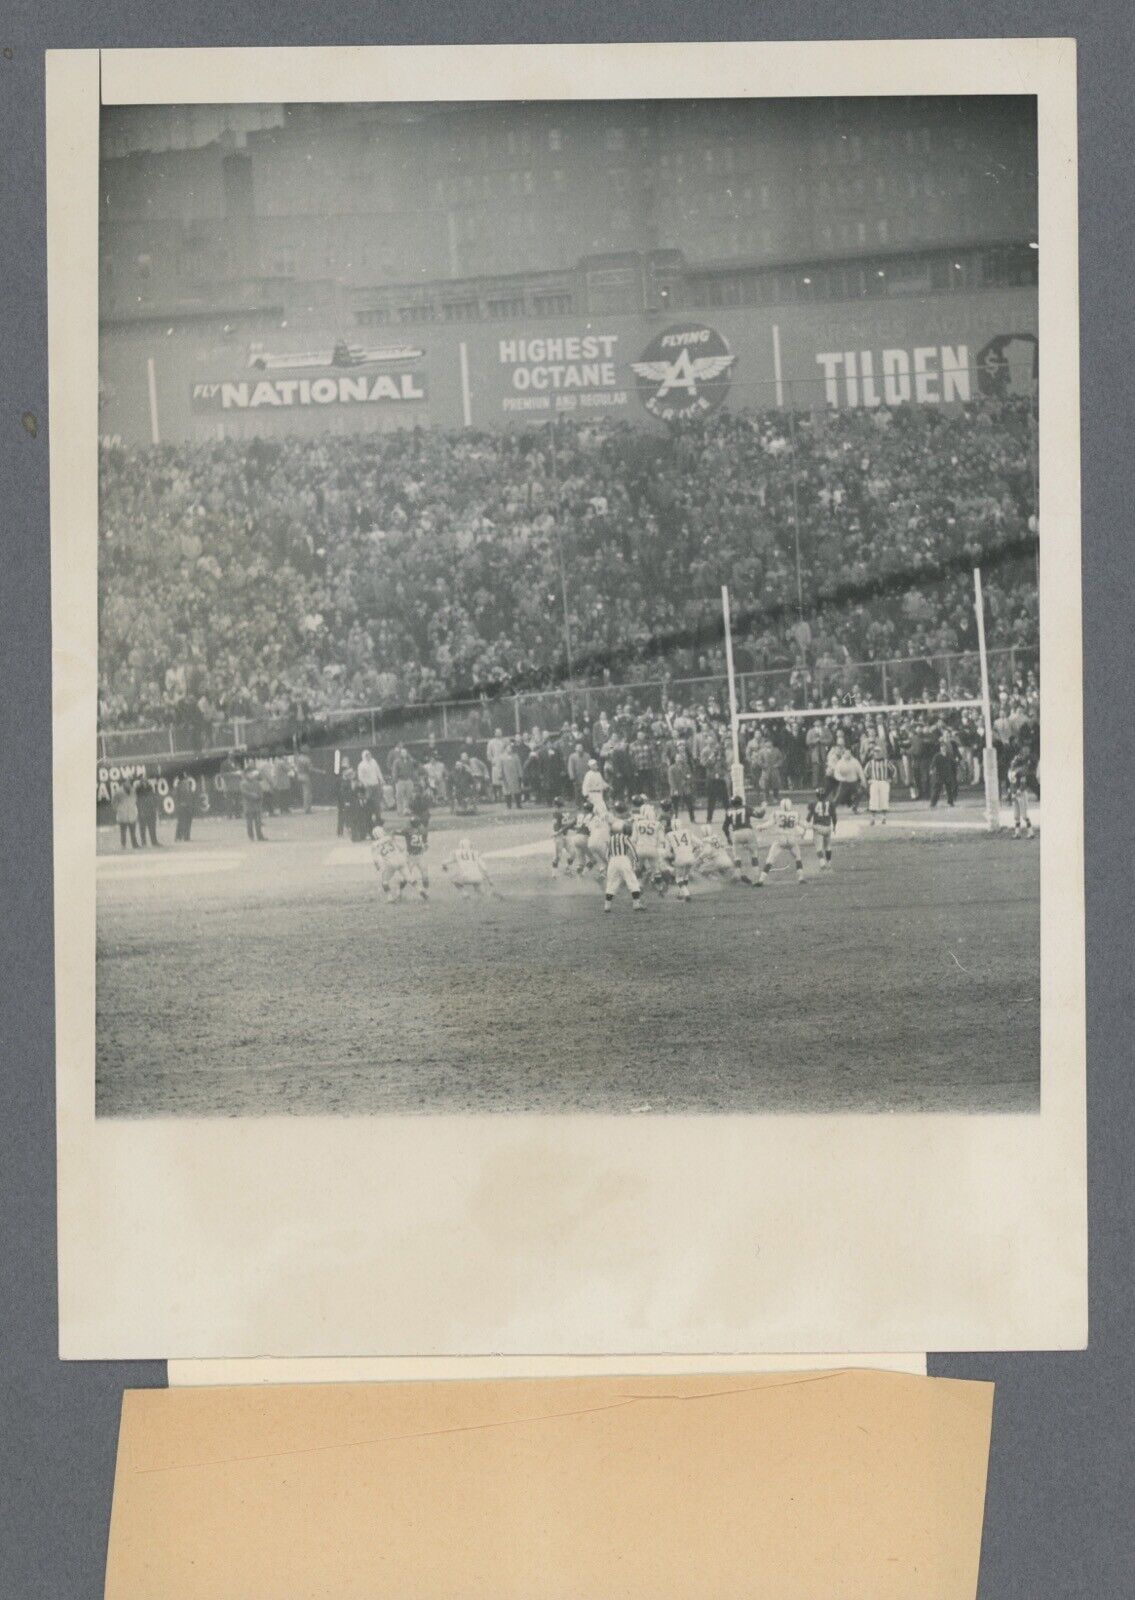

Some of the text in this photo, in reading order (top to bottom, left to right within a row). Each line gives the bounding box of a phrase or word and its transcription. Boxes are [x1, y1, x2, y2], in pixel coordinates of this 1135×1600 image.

[662, 328, 710, 348] FLYING
[499, 335, 618, 363] HIGHEST
[512, 362, 617, 390] OCTANE
[815, 345, 971, 409] TILDEN
[192, 374, 424, 409] FLY NATIONAL
[98, 764, 147, 783] DOWN
[814, 800, 830, 818] 41
[779, 813, 796, 828] 36
[637, 825, 656, 837] 65
[672, 832, 689, 847] 14
